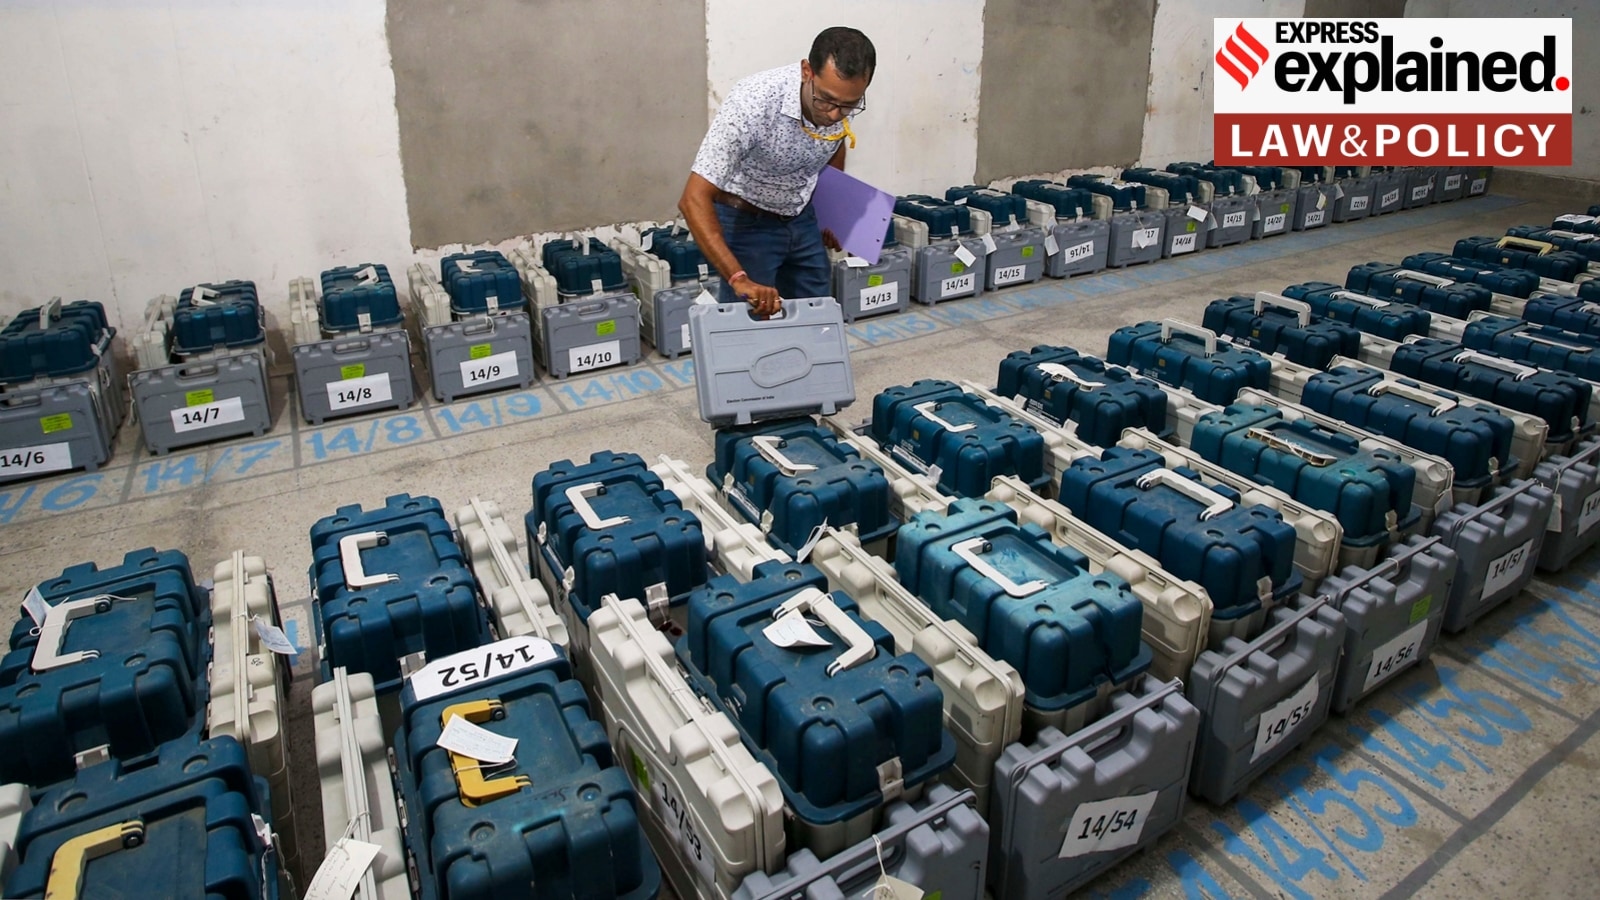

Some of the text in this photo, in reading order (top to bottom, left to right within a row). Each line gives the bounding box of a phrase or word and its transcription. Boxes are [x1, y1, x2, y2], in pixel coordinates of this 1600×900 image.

[1226, 214, 1243, 224] 14/19
[1267, 216, 1283, 226] 14/20
[1307, 214, 1321, 223] 14/21
[1069, 246, 1090, 259] 14/16
[998, 268, 1021, 280] 14/15
[945, 278, 970, 291] 14/14
[865, 291, 893, 306] 14/13
[576, 350, 612, 367] 14/10
[469, 363, 501, 382] 14/9
[337, 387, 373, 404] 14/8
[559, 368, 663, 407] 14/10
[182, 406, 220, 425] 14/7
[437, 394, 542, 433] 14/9
[306, 414, 424, 460] 14/8
[0, 451, 45, 468] 14/6
[141, 440, 281, 493] 14/7
[1491, 549, 1525, 579] 14/57
[437, 643, 536, 689] 14/52
[1374, 641, 1415, 678] 14/56
[1265, 700, 1312, 745] 14/55
[661, 782, 702, 861] 14/53
[1077, 808, 1138, 840] 14/54
